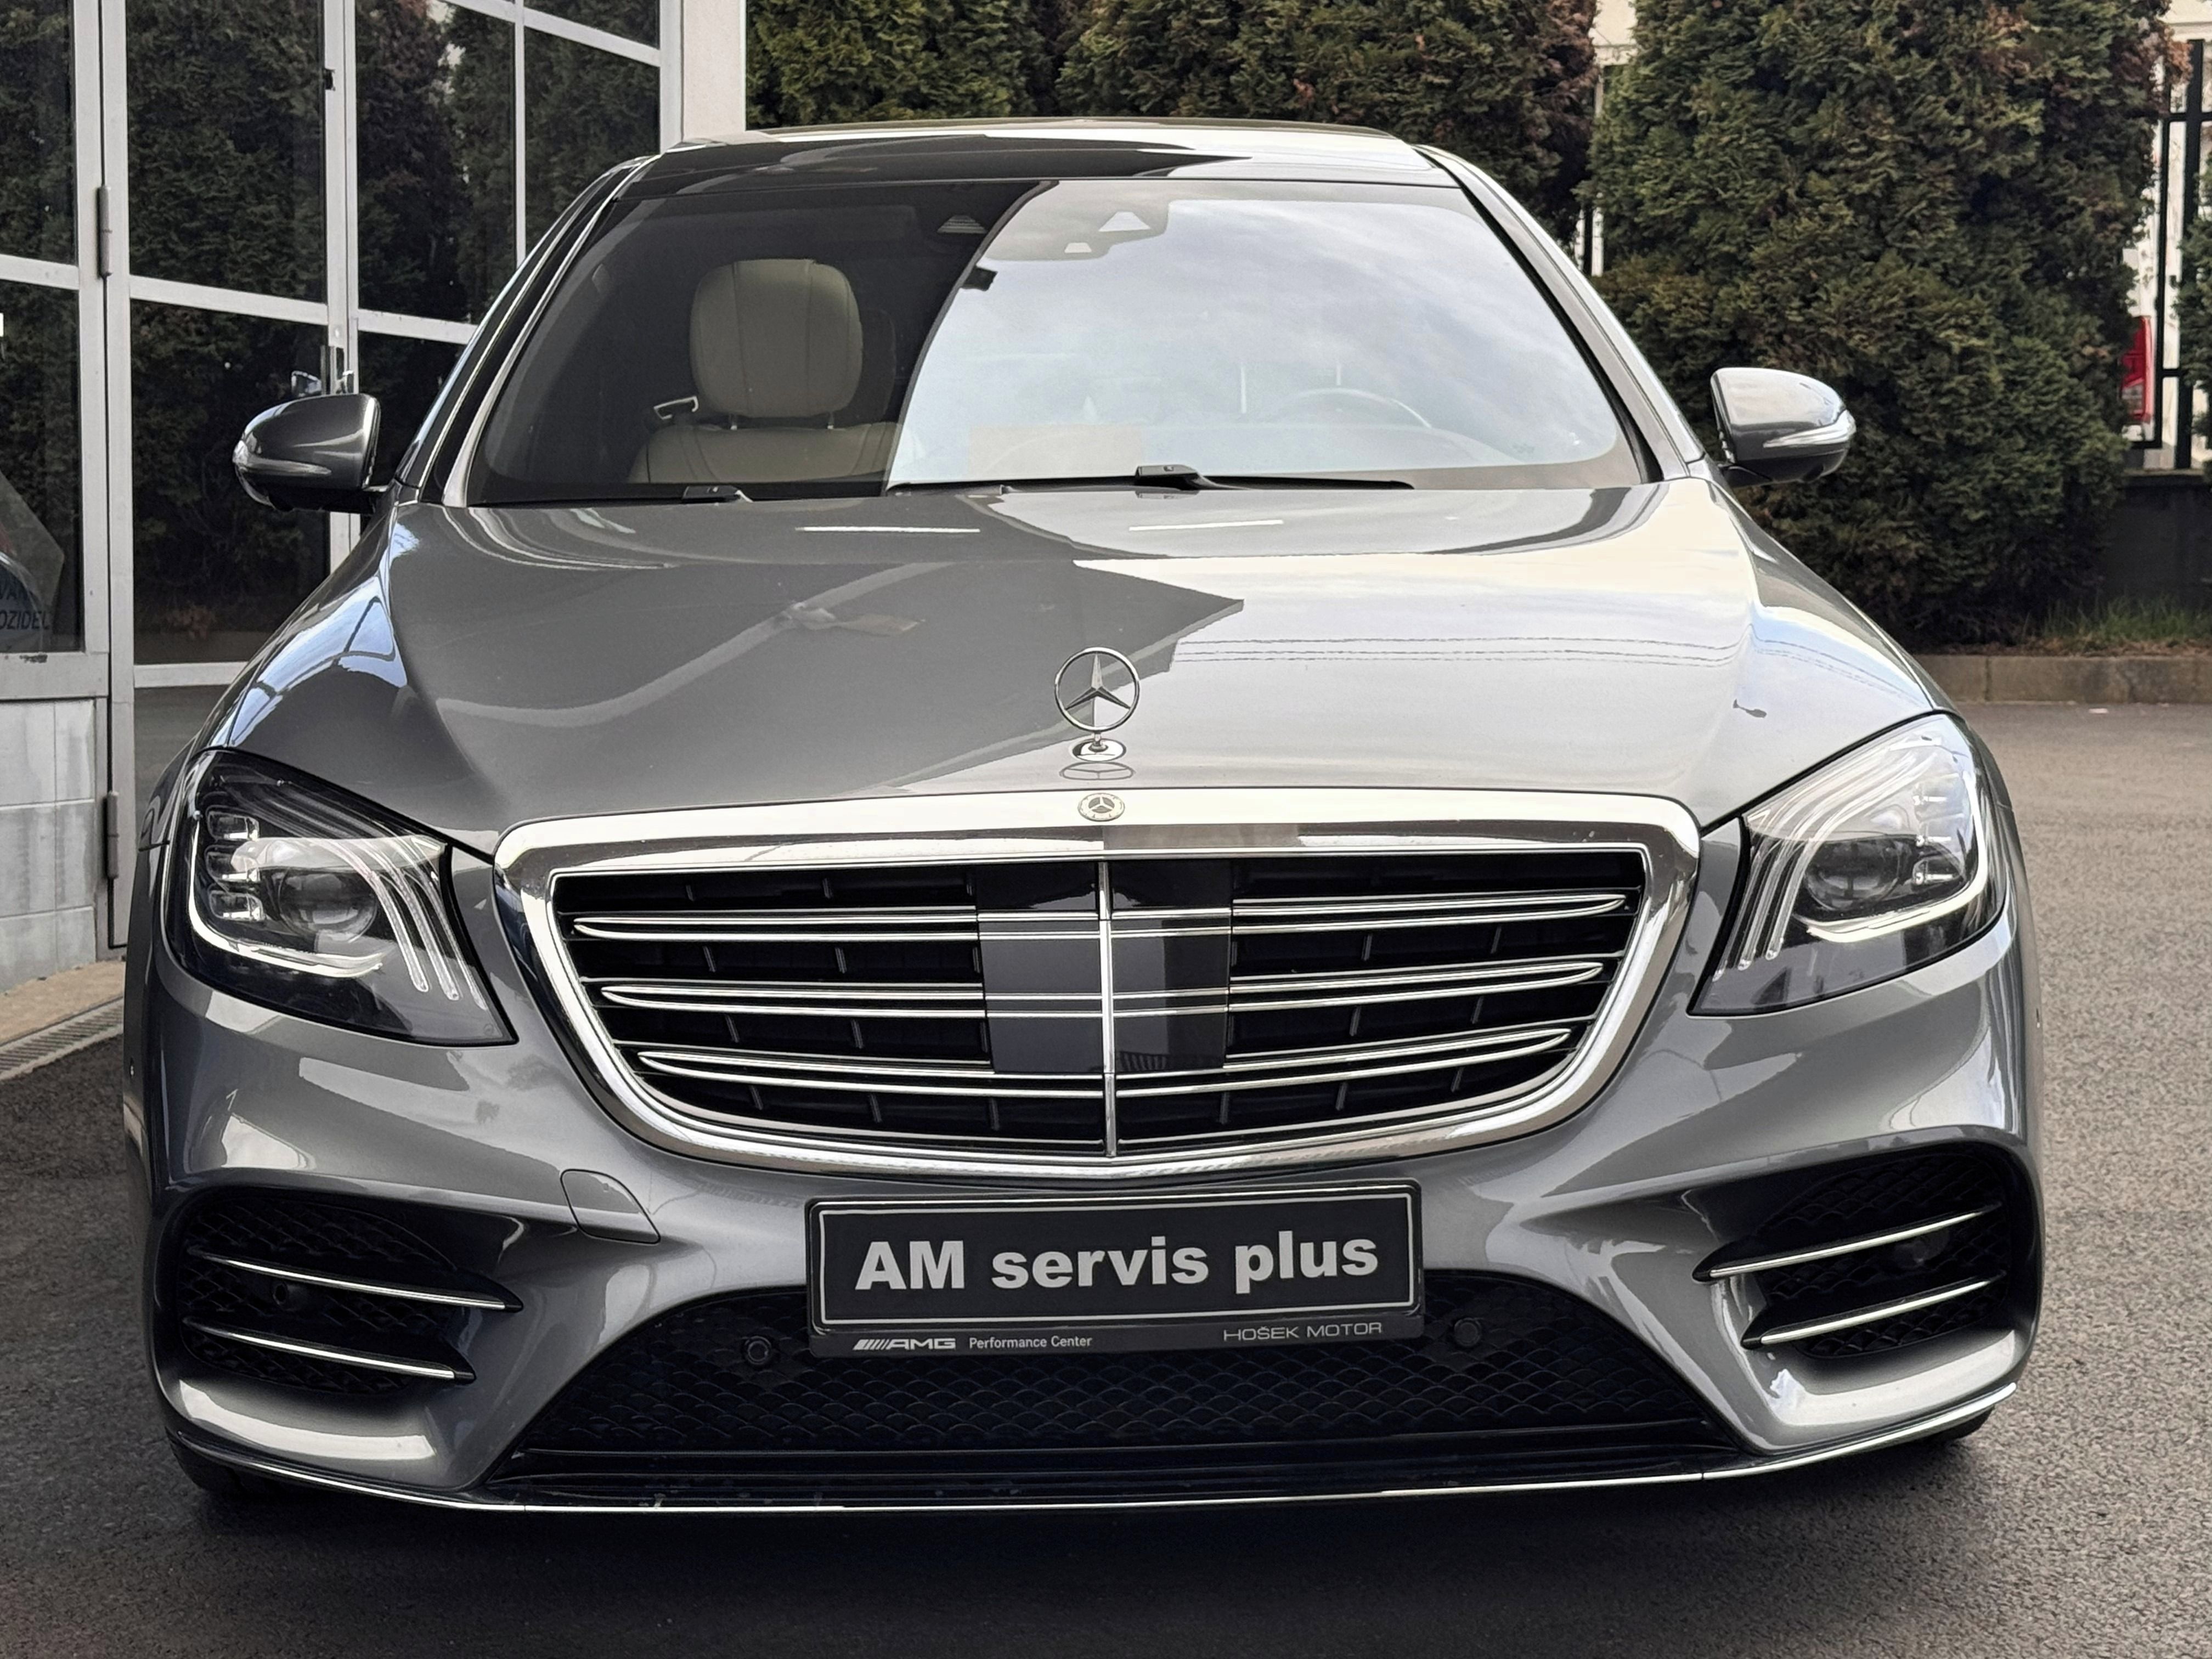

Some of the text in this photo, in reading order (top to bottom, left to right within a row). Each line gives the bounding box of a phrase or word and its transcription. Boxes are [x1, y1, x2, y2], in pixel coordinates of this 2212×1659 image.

[854, 1230, 1379, 1295] AM servis plus
[1223, 1322, 1382, 1341] HOŠEK MOTOR
[969, 1336, 1048, 1349] Performance
[1050, 1335, 1093, 1348] Center
